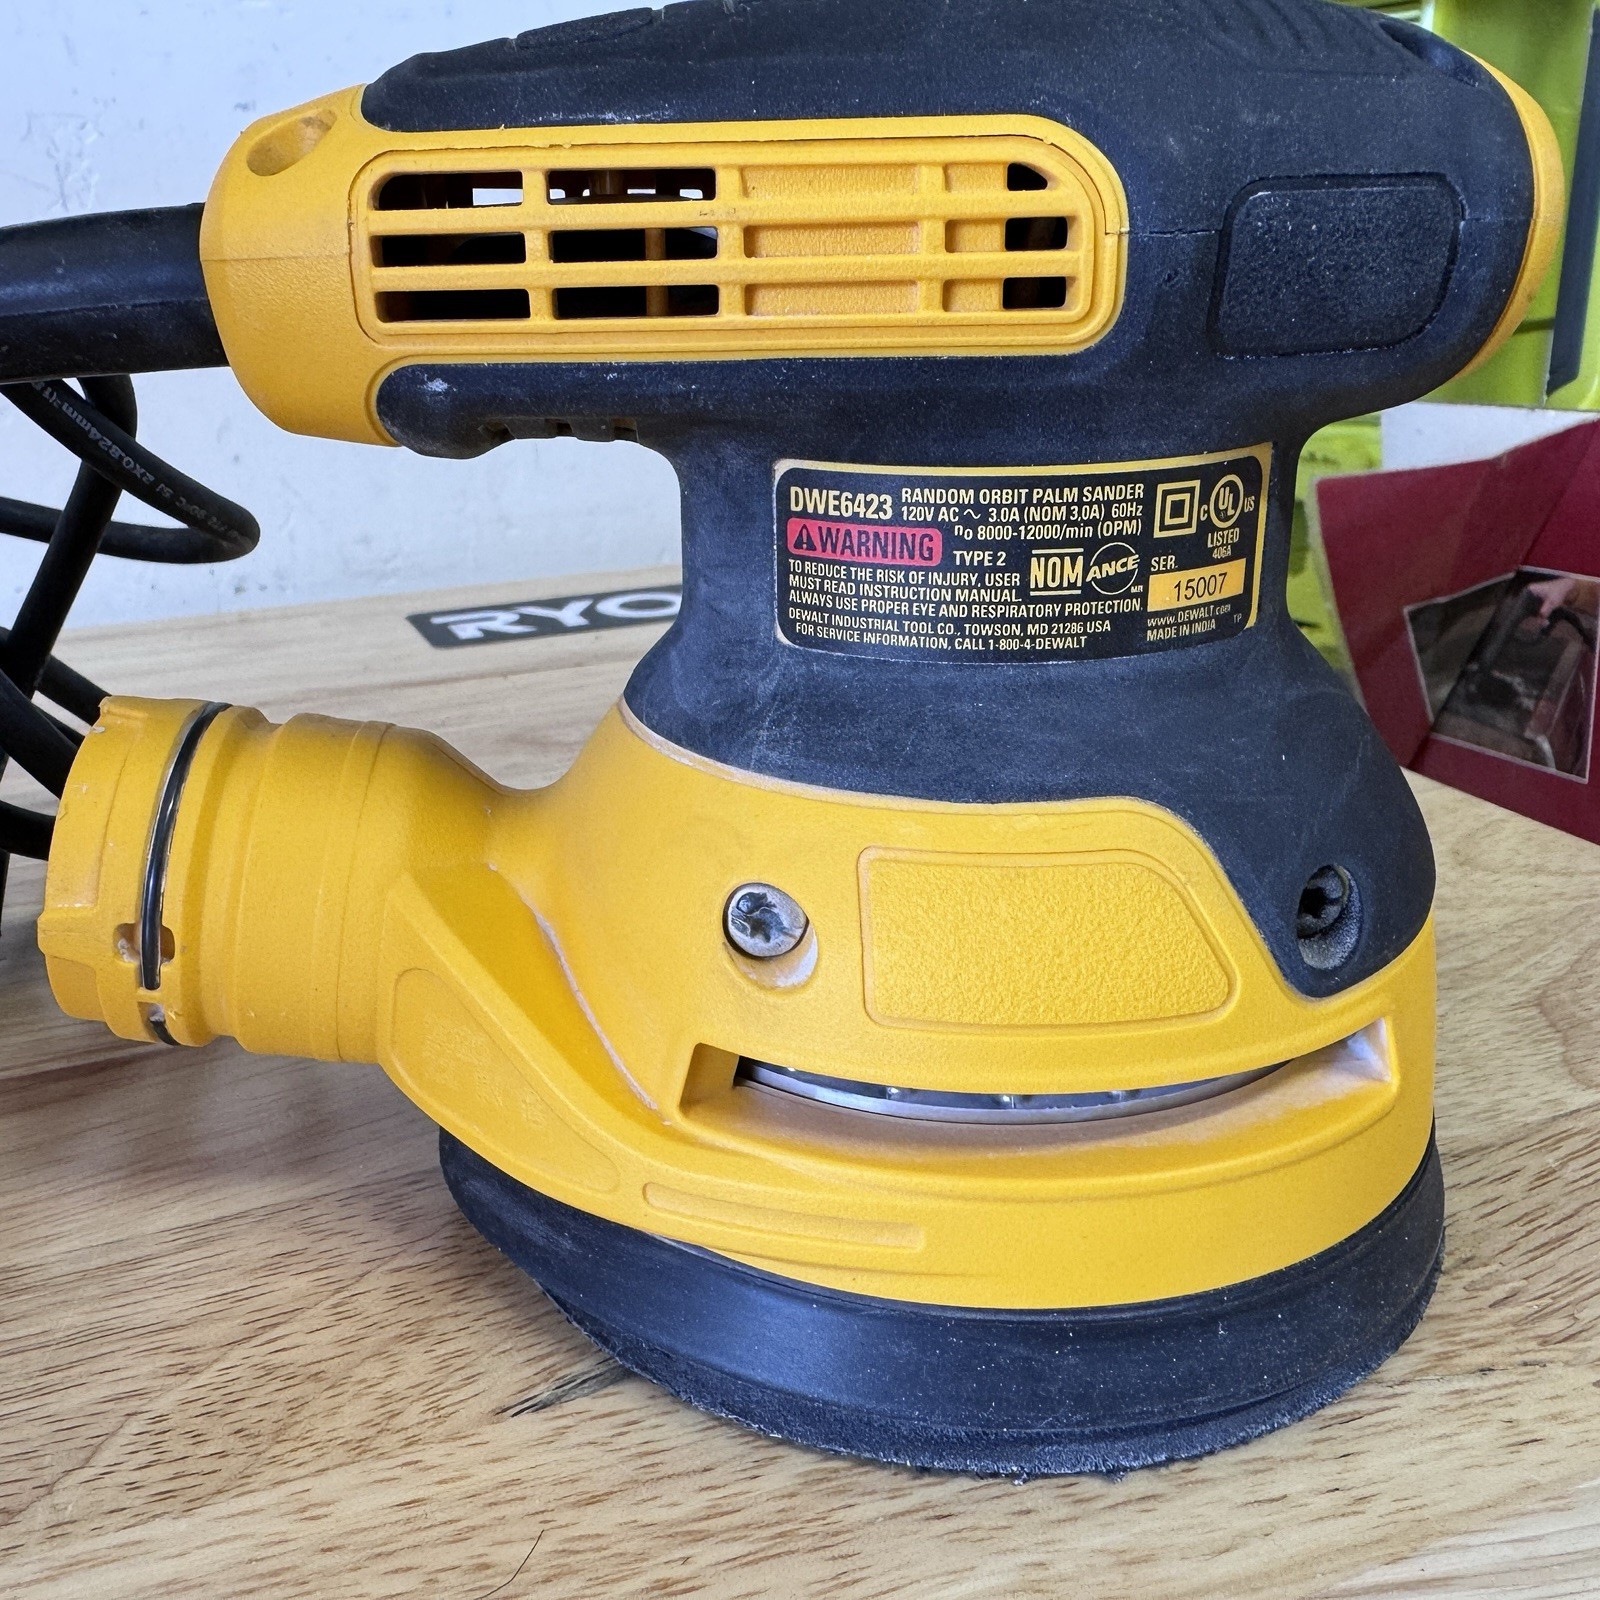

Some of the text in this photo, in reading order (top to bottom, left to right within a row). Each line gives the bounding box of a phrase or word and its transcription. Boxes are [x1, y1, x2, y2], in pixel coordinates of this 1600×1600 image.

[789, 485, 893, 521] DWE6423
[901, 483, 1145, 505] RANDOM ORBIT PALM SANDER
[901, 505, 935, 522] 120V
[937, 506, 960, 523] AC
[988, 506, 1021, 523] 3.0A
[1024, 504, 1067, 524] (NOM
[1111, 502, 1143, 519] 60Hz
[817, 525, 935, 562] WARNING
[977, 522, 1094, 541] 8000-12000/min
[1097, 518, 1143, 540] (OPM)
[1206, 526, 1241, 549] LISTED
[788, 558, 1021, 588] TO REDUCE THE RISK OF INJURY, USER
[953, 550, 1007, 568] TYPE 2
[1029, 554, 1085, 590] NOM
[1085, 553, 1141, 583] ANCE
[1150, 554, 1179, 572] SER.
[788, 573, 822, 591] MUST
[823, 578, 856, 596] READ
[859, 582, 952, 602] INSTRUCTION
[1173, 571, 1228, 602] 15007
[788, 588, 1144, 619] ALWAYS USE PROPER EYE AND RESPIRATORY PROTECTION.
[788, 606, 1112, 637] DEWALT INDUSTRIAL TOOL CO., TOWSON, MD 21286 USA
[795, 621, 1088, 651] FOR SERVICE INFORMATION, CALL 1-800-4-DEWALT
[1146, 618, 1217, 642] MADE IN INDIA
